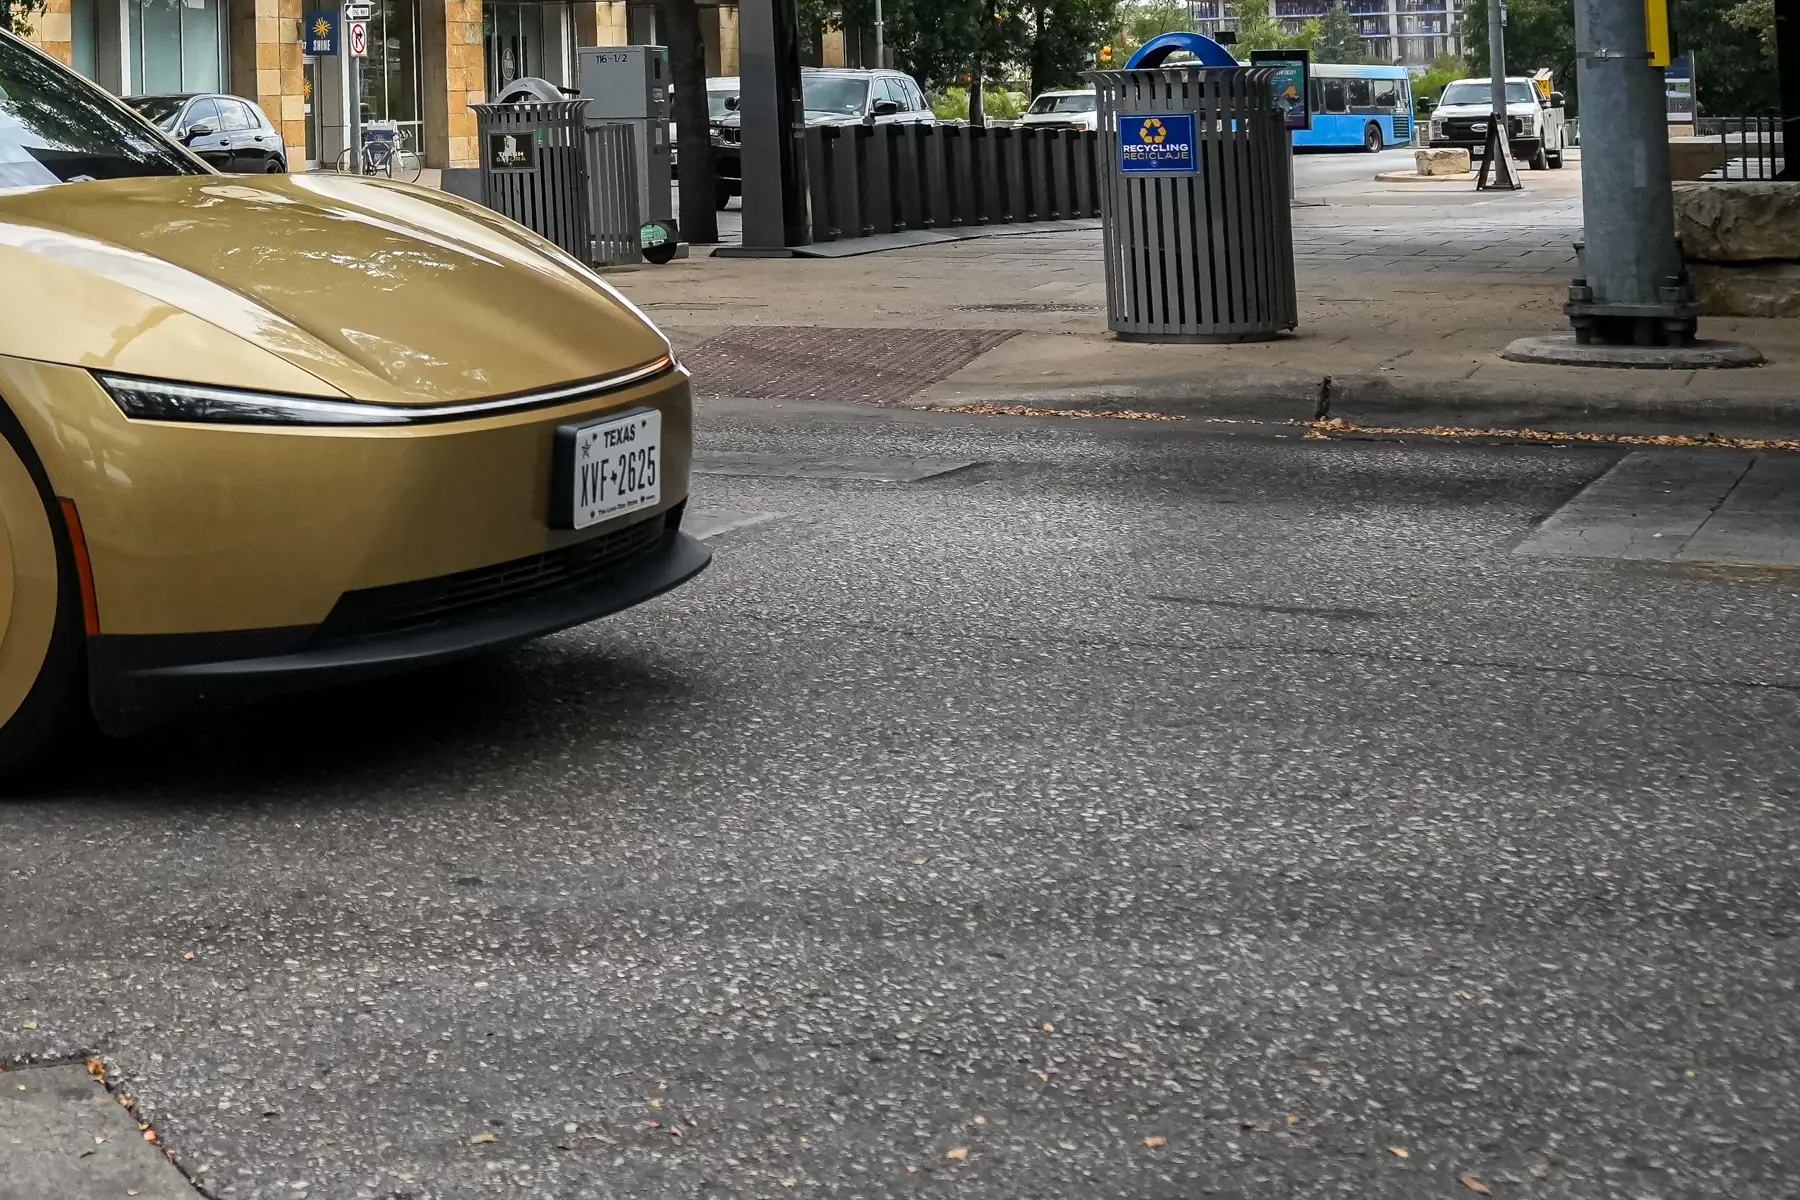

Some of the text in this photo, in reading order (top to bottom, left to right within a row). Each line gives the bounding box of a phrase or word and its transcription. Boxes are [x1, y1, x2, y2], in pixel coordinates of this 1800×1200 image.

[313, 39, 331, 51] SHINE
[1123, 143, 1189, 152] RECYCLING
[1123, 151, 1189, 160] RECICLAJE
[604, 424, 636, 448] TEXAS
[618, 445, 656, 496] 2625
